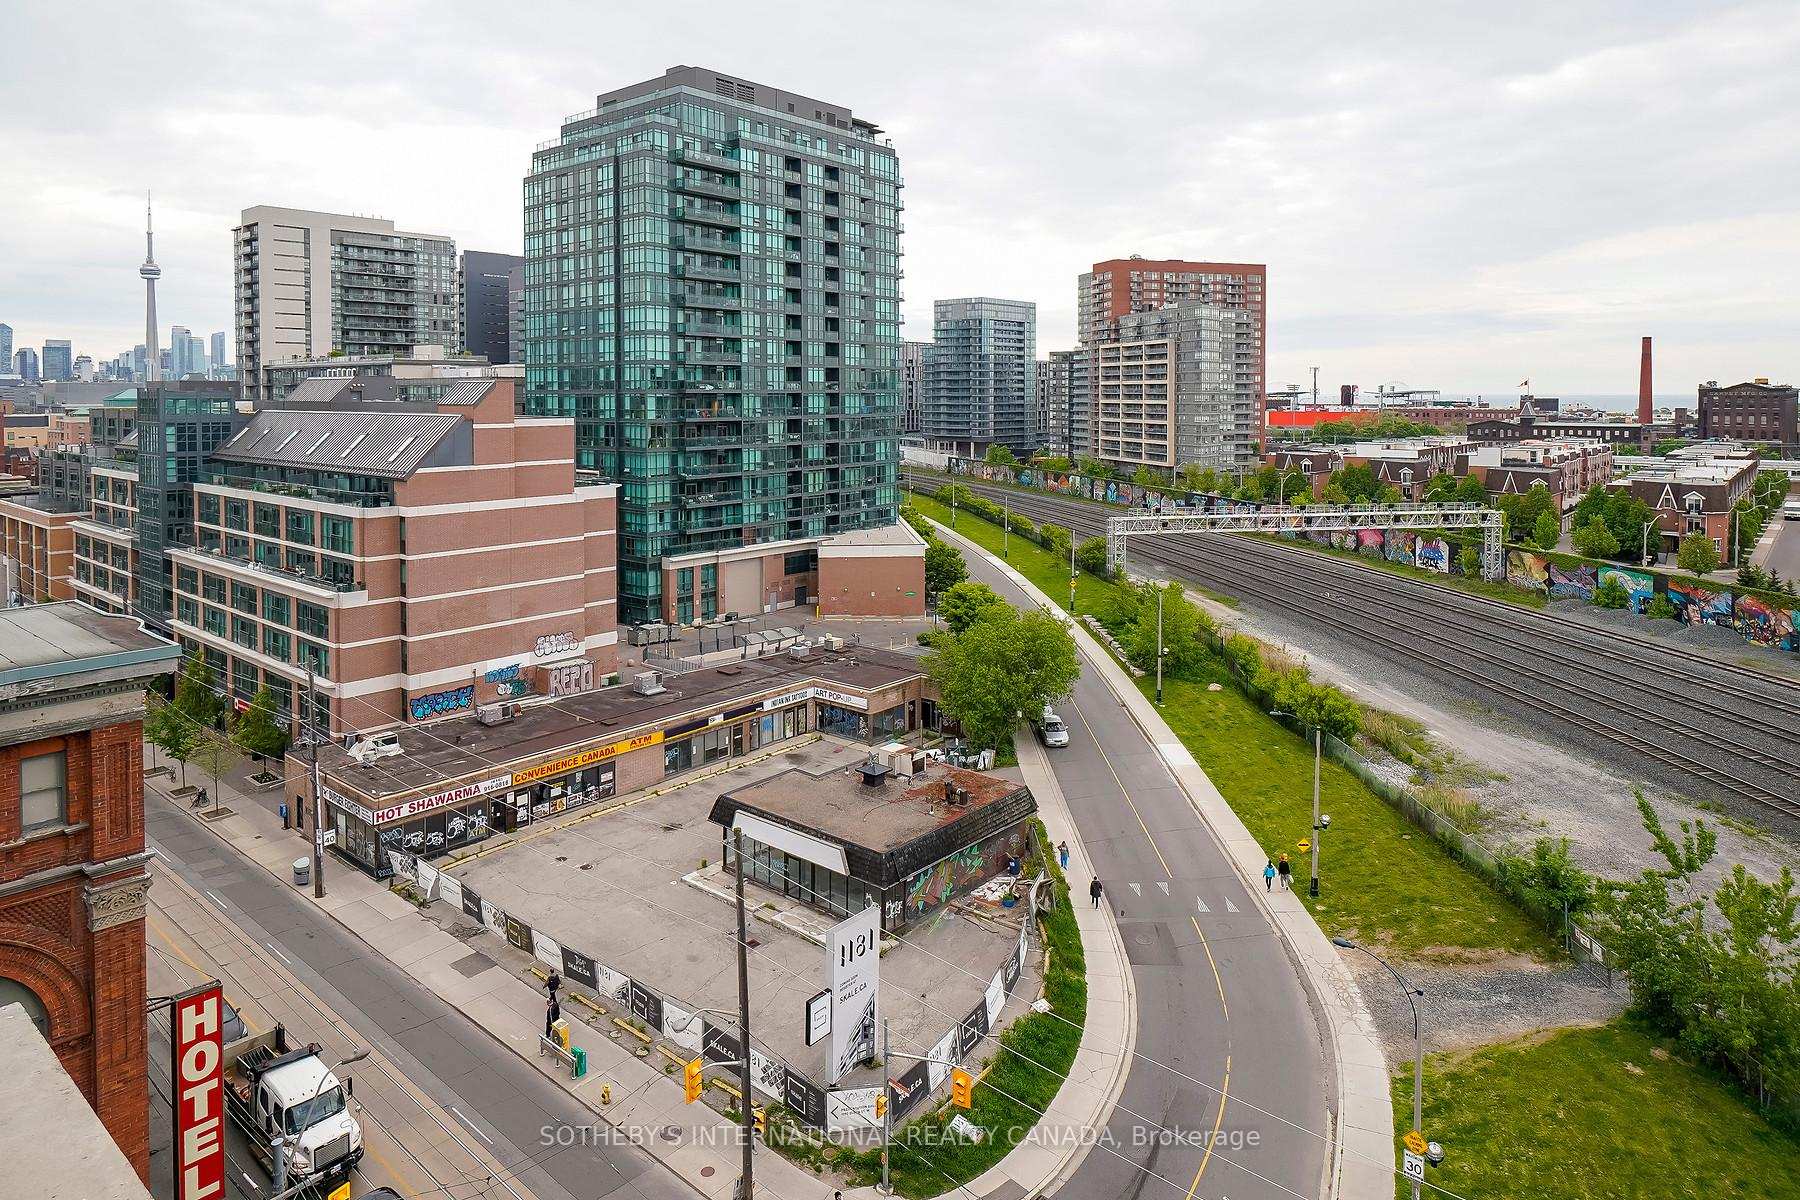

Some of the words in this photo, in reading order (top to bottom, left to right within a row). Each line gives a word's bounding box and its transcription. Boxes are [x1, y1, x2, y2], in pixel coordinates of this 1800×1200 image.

[815, 688, 828, 698] ART
[828, 691, 853, 705] POP-UP
[629, 734, 652, 746] ATM
[514, 756, 579, 783] CONVENIENCE
[581, 746, 616, 764] CANADA
[375, 805, 404, 821] HOT
[408, 784, 481, 814] SHAWARMA
[324, 835, 336, 843] 40
[840, 927, 874, 968] 1181
[839, 982, 868, 1005] SKALE.CA
[181, 996, 220, 1200] HOTEL
[1405, 1160, 1422, 1175] 30
